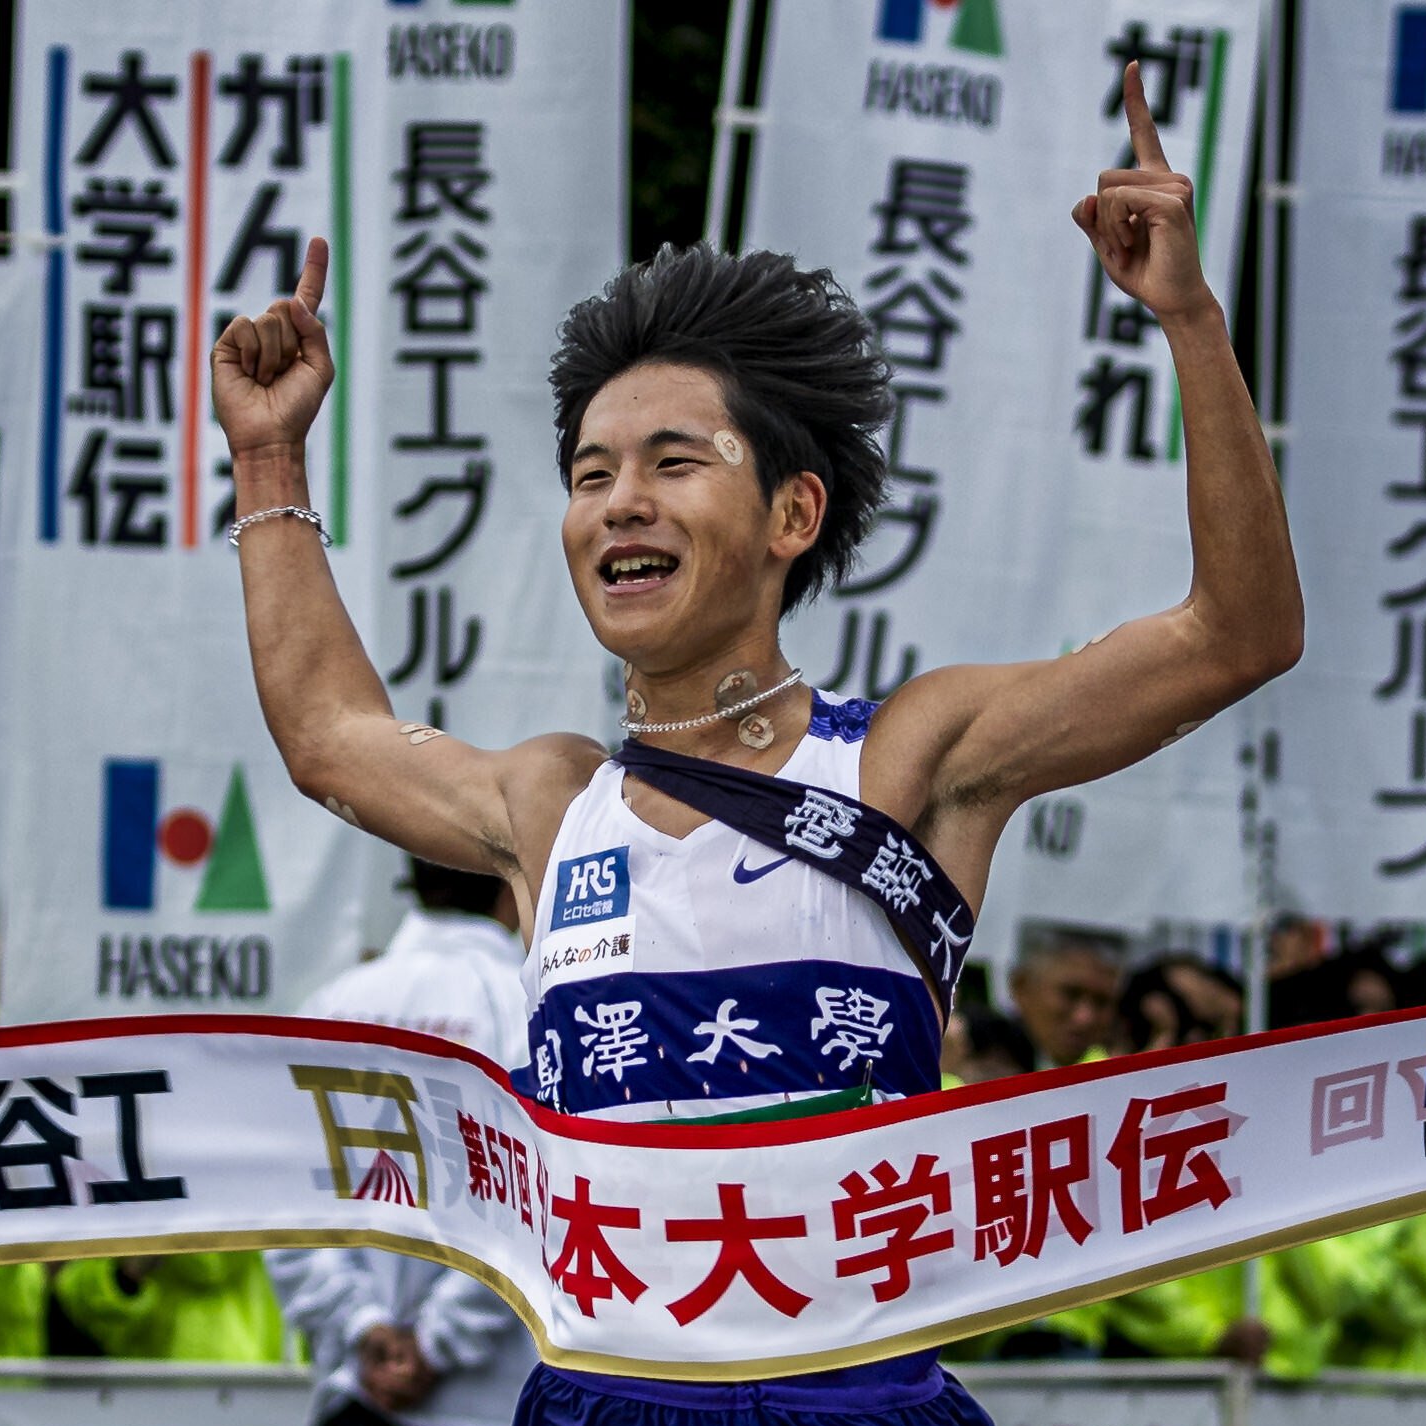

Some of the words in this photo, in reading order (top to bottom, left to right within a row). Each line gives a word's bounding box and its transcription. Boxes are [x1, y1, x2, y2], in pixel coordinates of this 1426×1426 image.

[864, 57, 1002, 128] HASEKO
[66, 49, 180, 549] 大学駅伝
[566, 856, 616, 902] HRS
[98, 932, 271, 1000] HASEKO
[541, 933, 631, 978] みんなの介護
[535, 1082, 1229, 1327] 本大学駅伝
